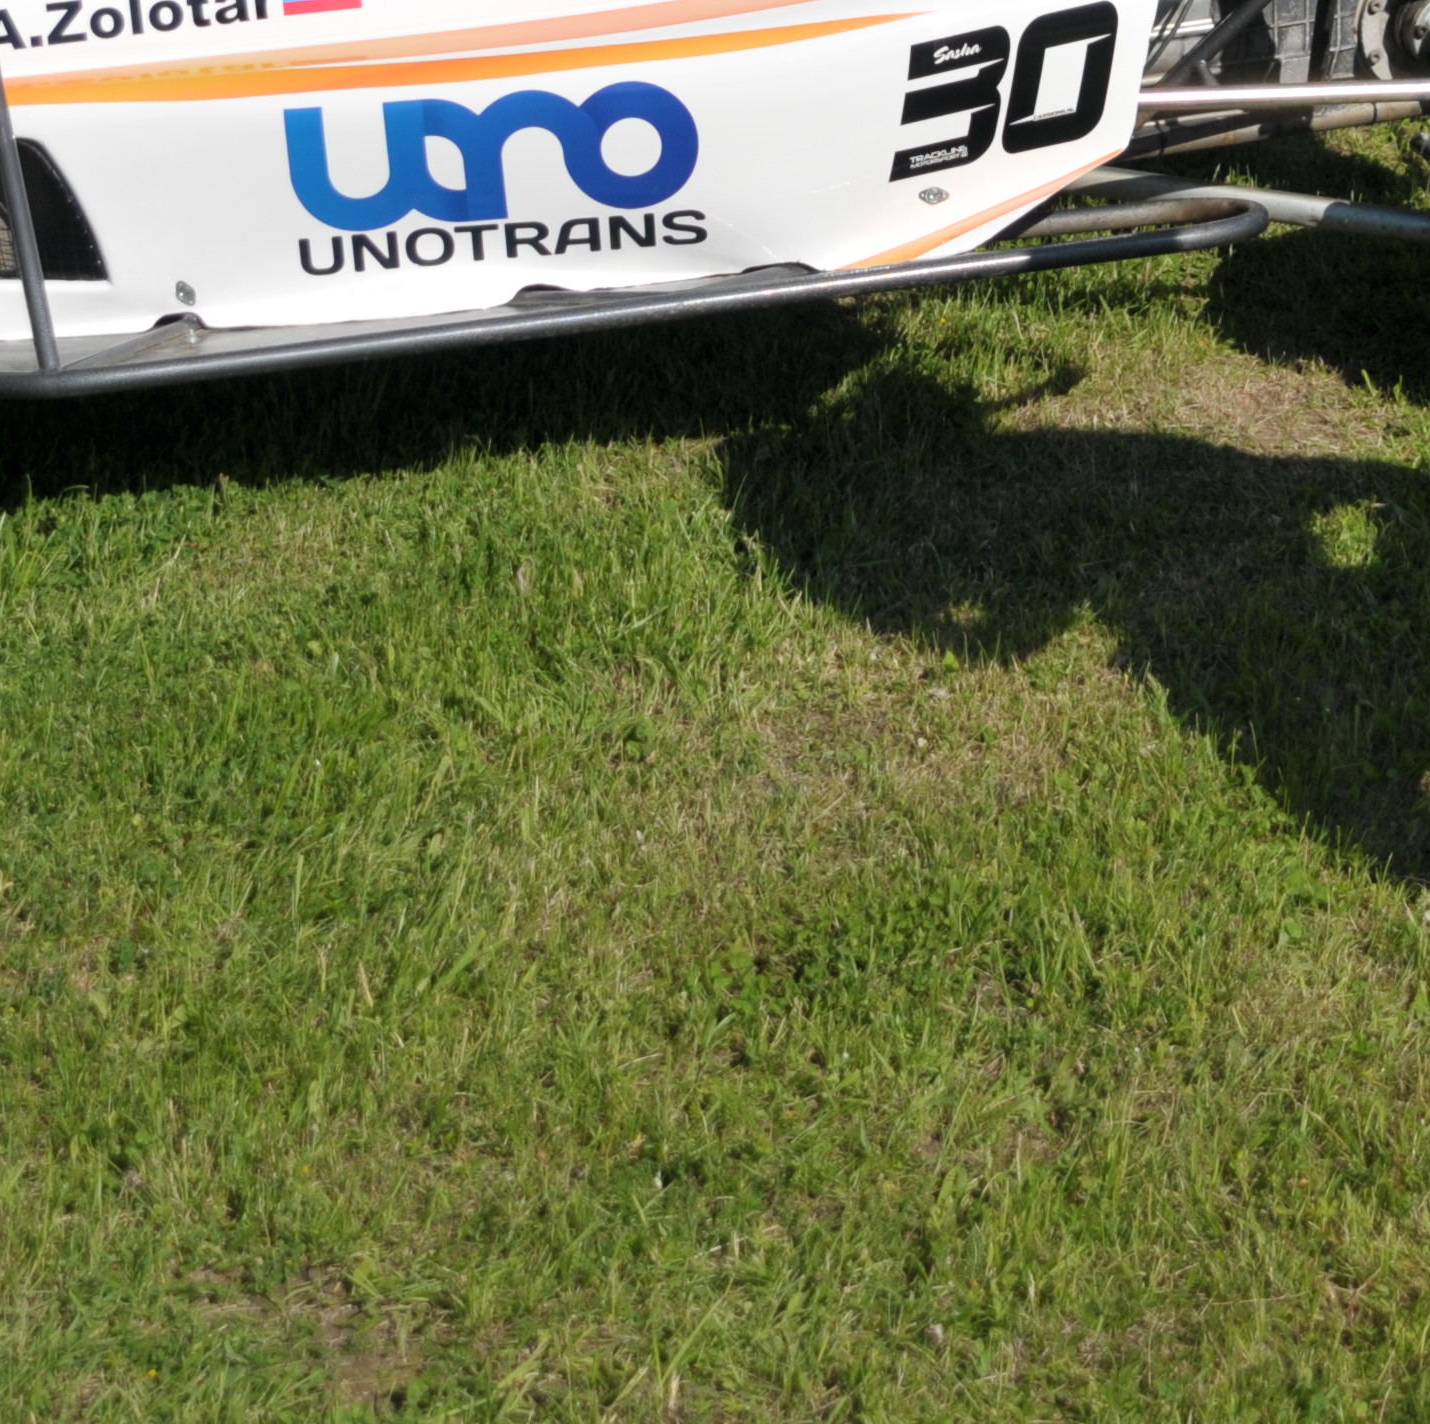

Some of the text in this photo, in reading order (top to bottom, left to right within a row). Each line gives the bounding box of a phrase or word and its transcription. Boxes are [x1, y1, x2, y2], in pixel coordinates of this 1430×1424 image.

[933, 42, 982, 65] Sasha
[888, 0, 1119, 183] 30
[298, 209, 709, 276] UNOTRANS
